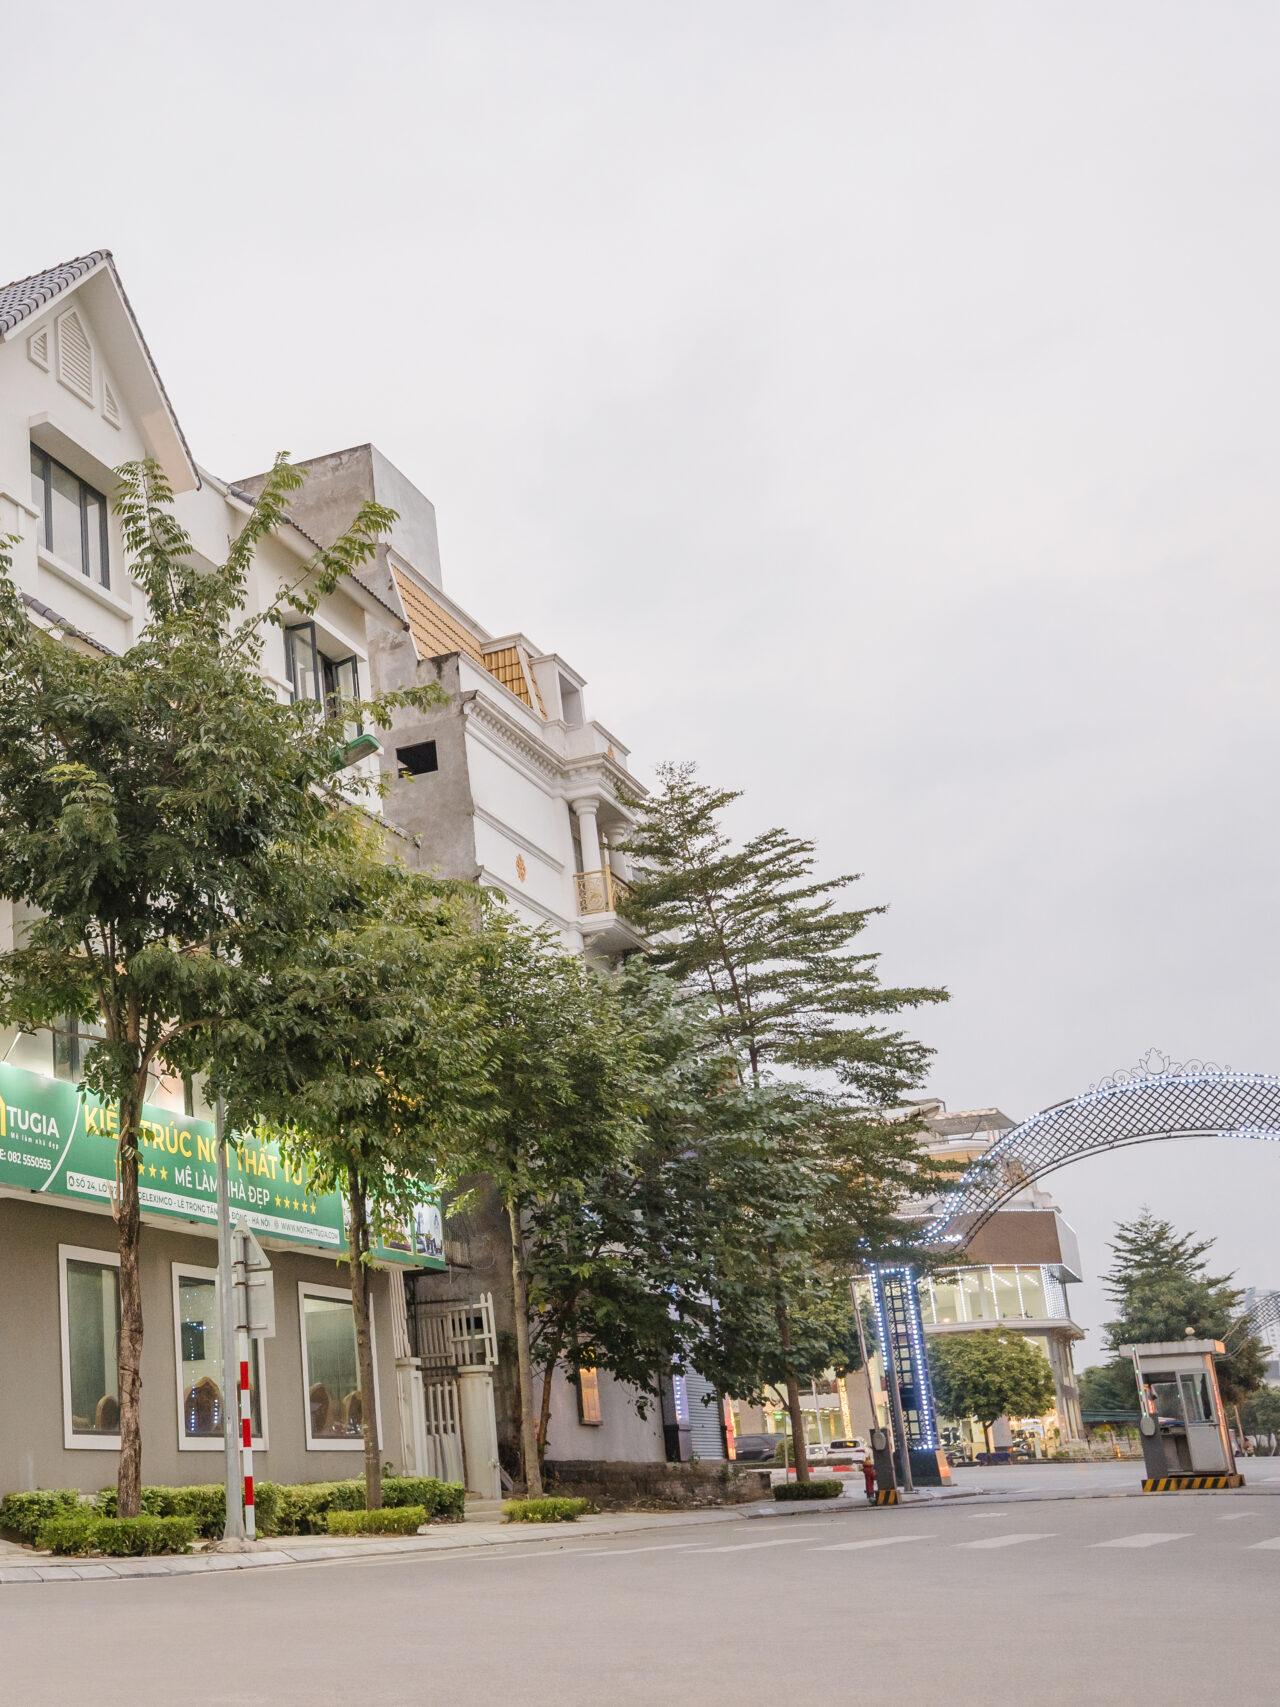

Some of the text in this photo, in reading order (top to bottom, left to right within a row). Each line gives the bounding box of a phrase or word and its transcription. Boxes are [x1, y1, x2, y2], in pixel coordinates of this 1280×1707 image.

[6, 1105, 60, 1138] TUGIA
[83, 1103, 121, 1140] KIẾ
[139, 1120, 193, 1157] TRÚC
[7, 1150, 22, 1164] 082
[22, 1154, 52, 1170] 5550555
[174, 1165, 270, 1209] MÊ LÀM HÀ ĐẸP
[231, 1210, 248, 1223] ĐÔG
